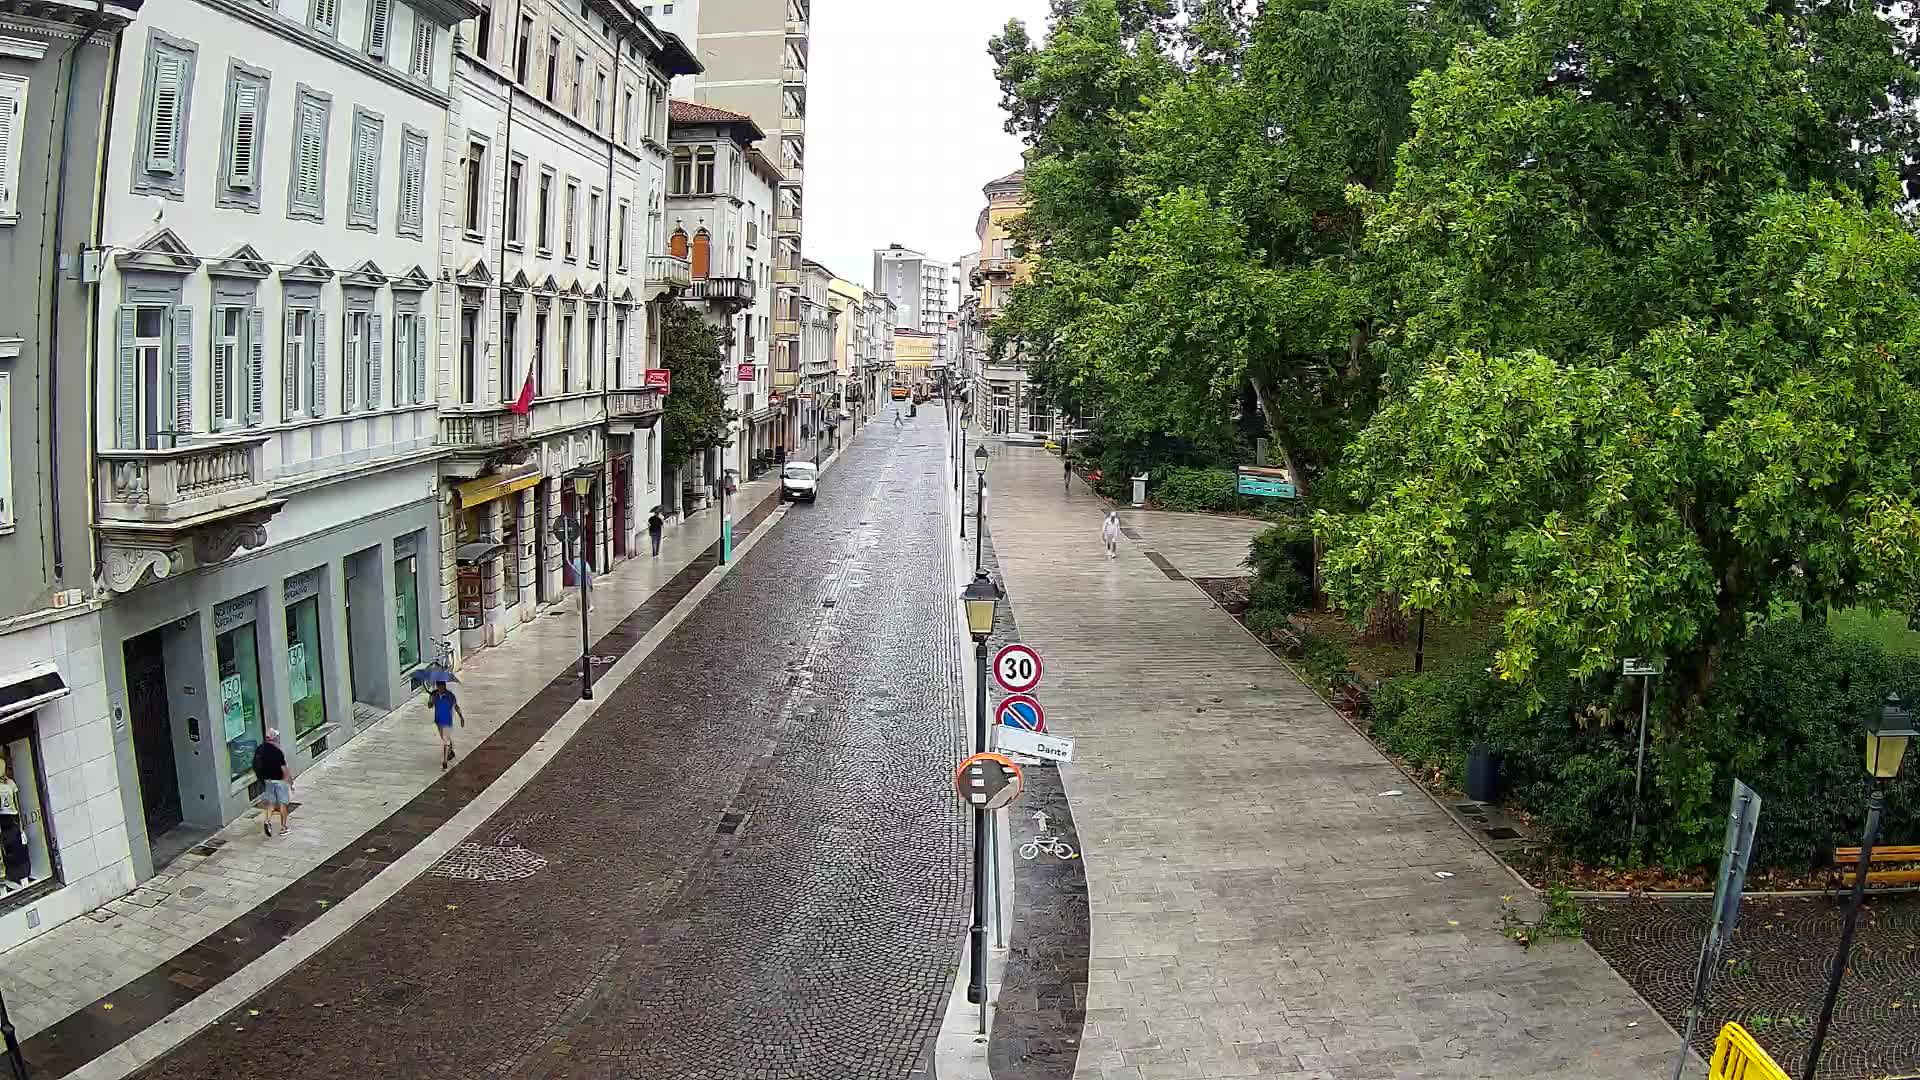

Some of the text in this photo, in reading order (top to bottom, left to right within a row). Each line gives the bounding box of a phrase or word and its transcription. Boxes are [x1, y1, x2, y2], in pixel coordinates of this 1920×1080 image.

[1005, 658, 1032, 679] 30
[221, 678, 240, 700] 130
[1037, 744, 1068, 757] Dante
